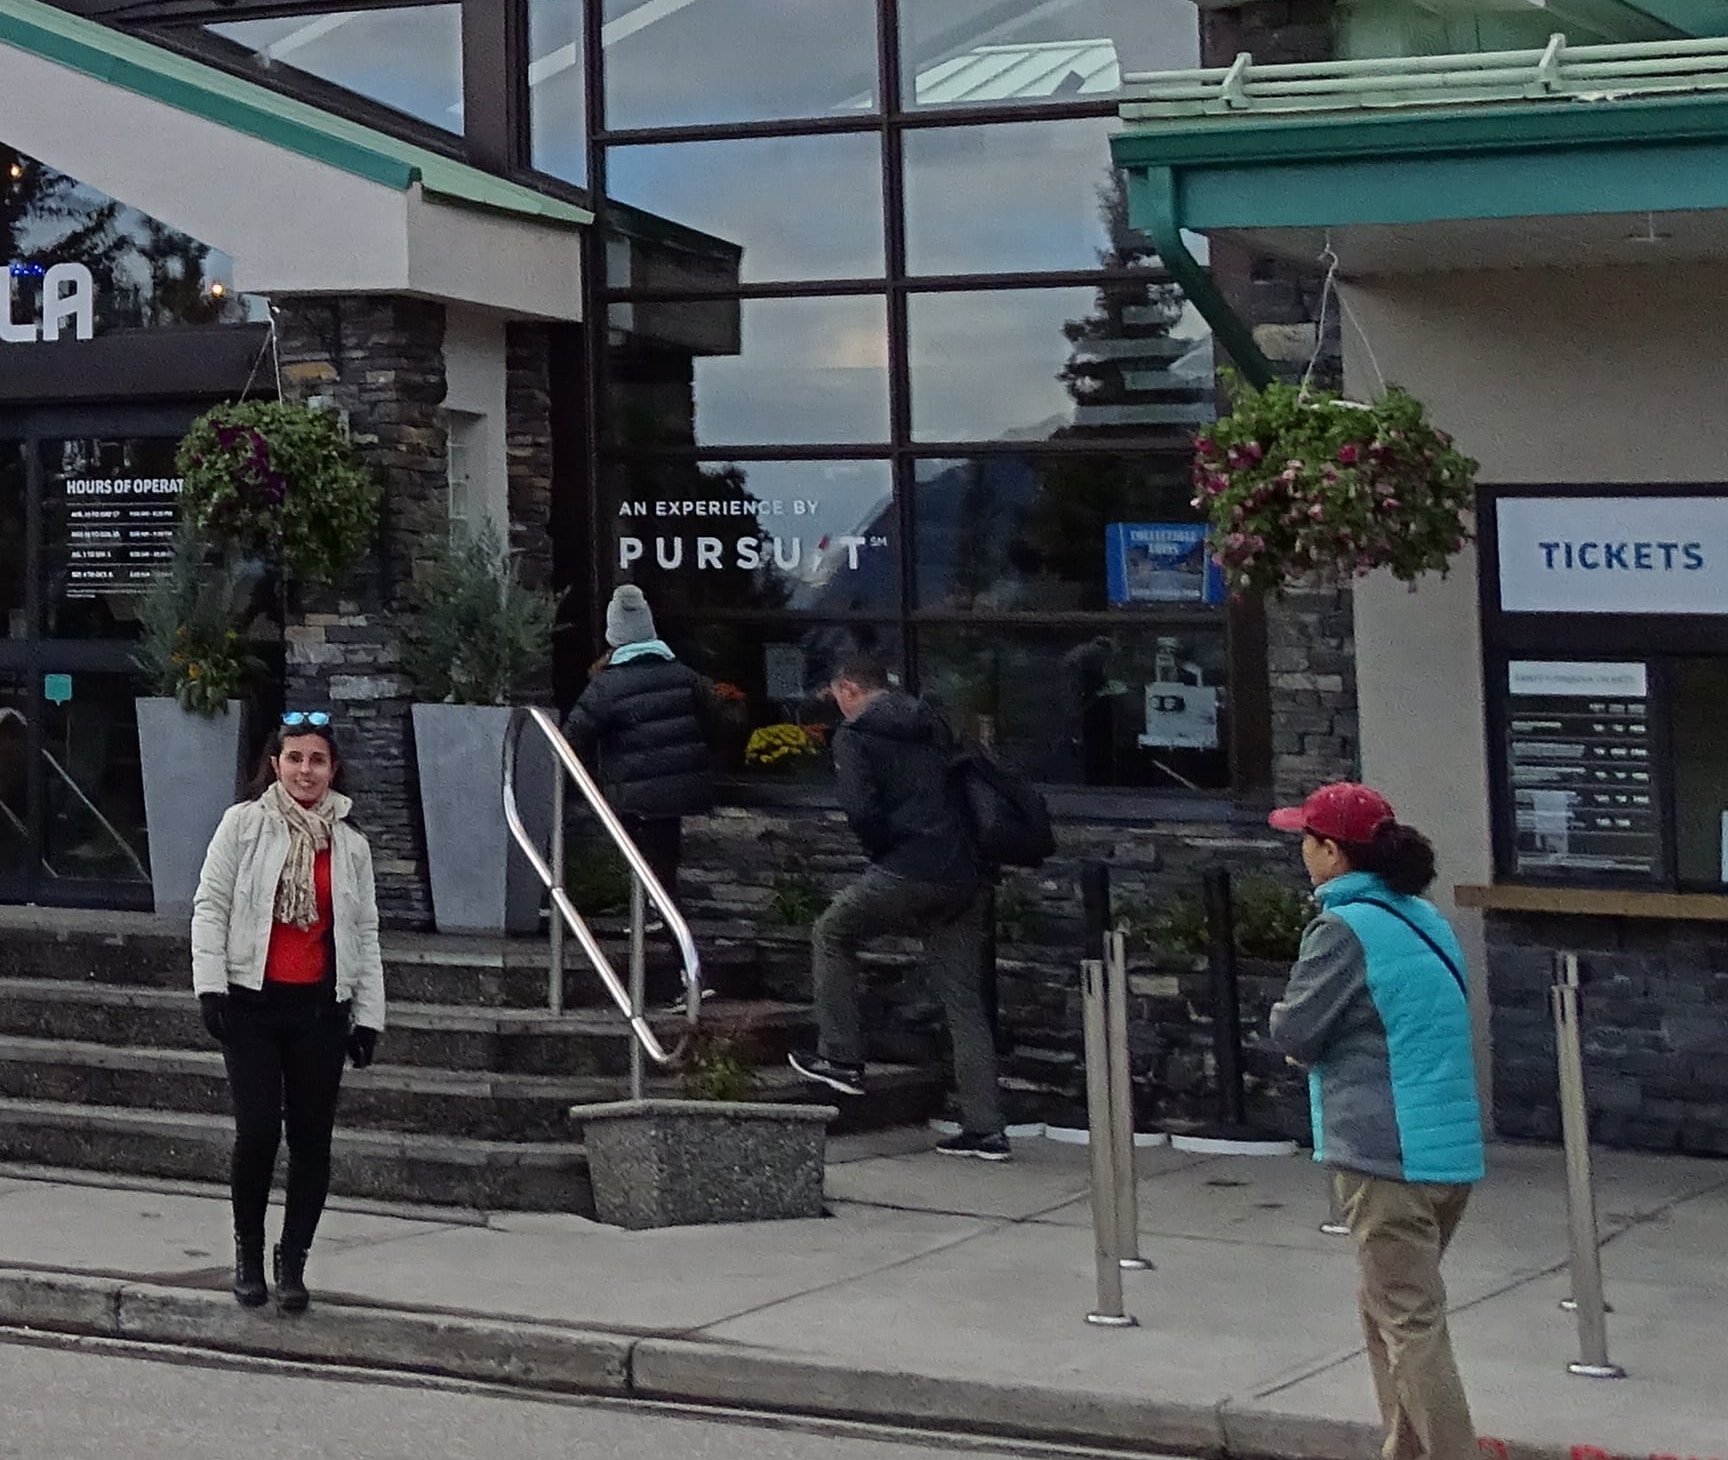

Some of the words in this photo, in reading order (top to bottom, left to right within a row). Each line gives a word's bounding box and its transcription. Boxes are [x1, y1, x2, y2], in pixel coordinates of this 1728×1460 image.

[66, 479, 112, 495] HOURS
[113, 478, 132, 494] OF
[133, 478, 185, 494] OPERAT
[619, 501, 647, 516] AN
[655, 500, 785, 516] EXPERIENCE
[794, 500, 819, 515] BY
[1539, 541, 1704, 571] TICKETS
